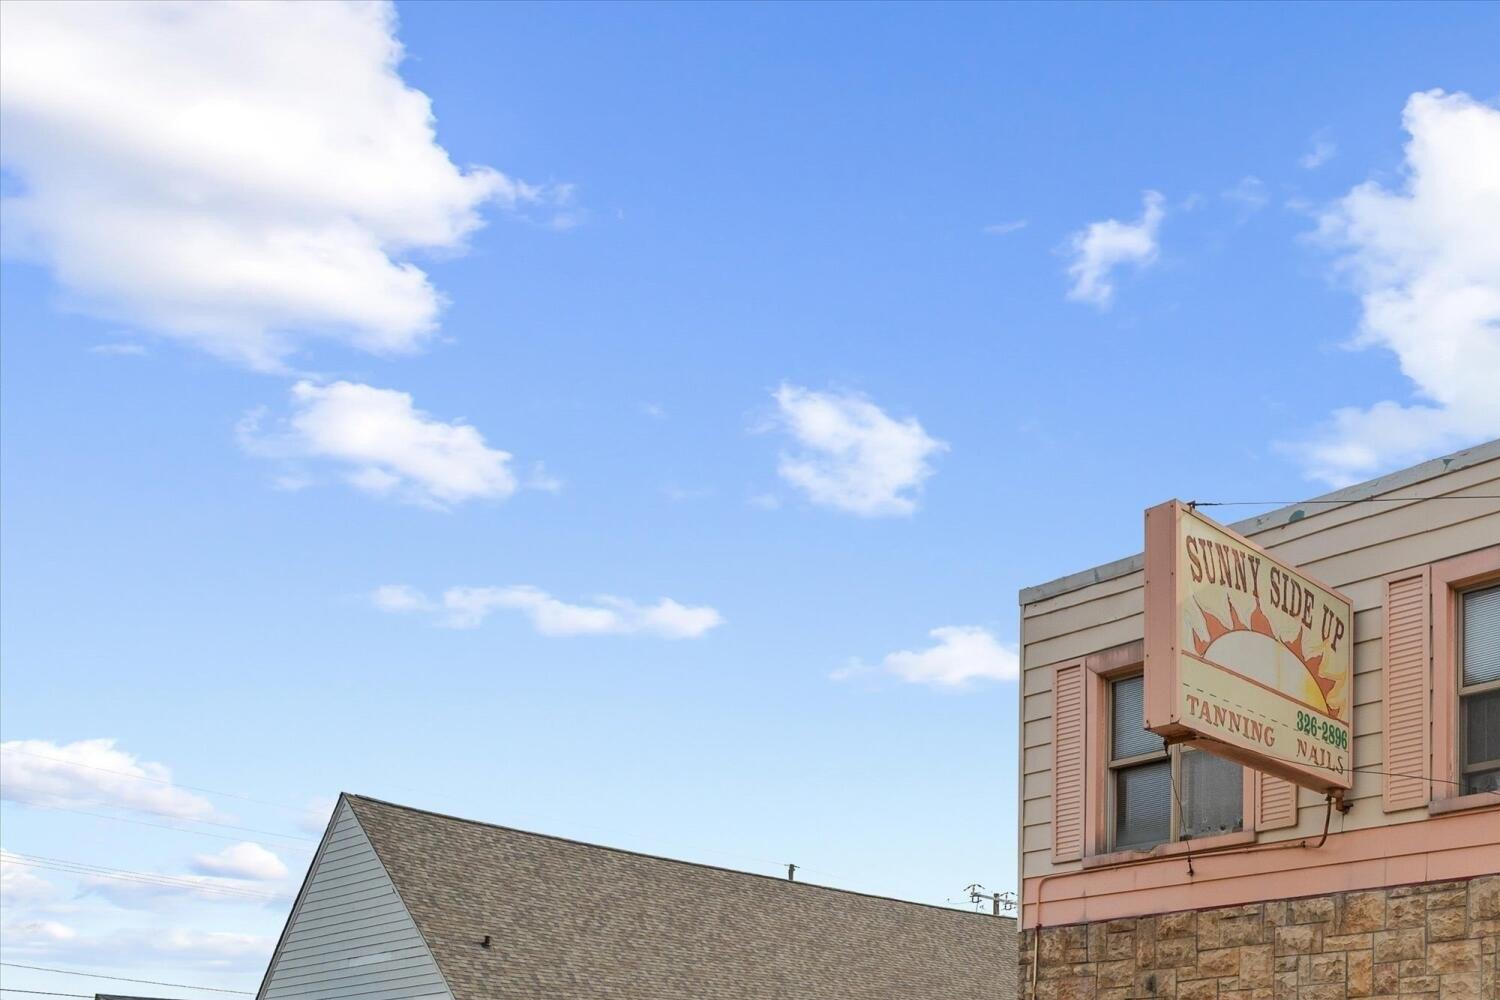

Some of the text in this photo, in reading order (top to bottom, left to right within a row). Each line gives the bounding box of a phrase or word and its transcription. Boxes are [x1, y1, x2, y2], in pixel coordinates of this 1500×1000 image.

[1186, 535, 1345, 652] SUNNY SIDE UP
[1186, 694, 1275, 747] TANNING
[1297, 710, 1348, 750] 326-2896
[1296, 737, 1344, 775] NAILS
